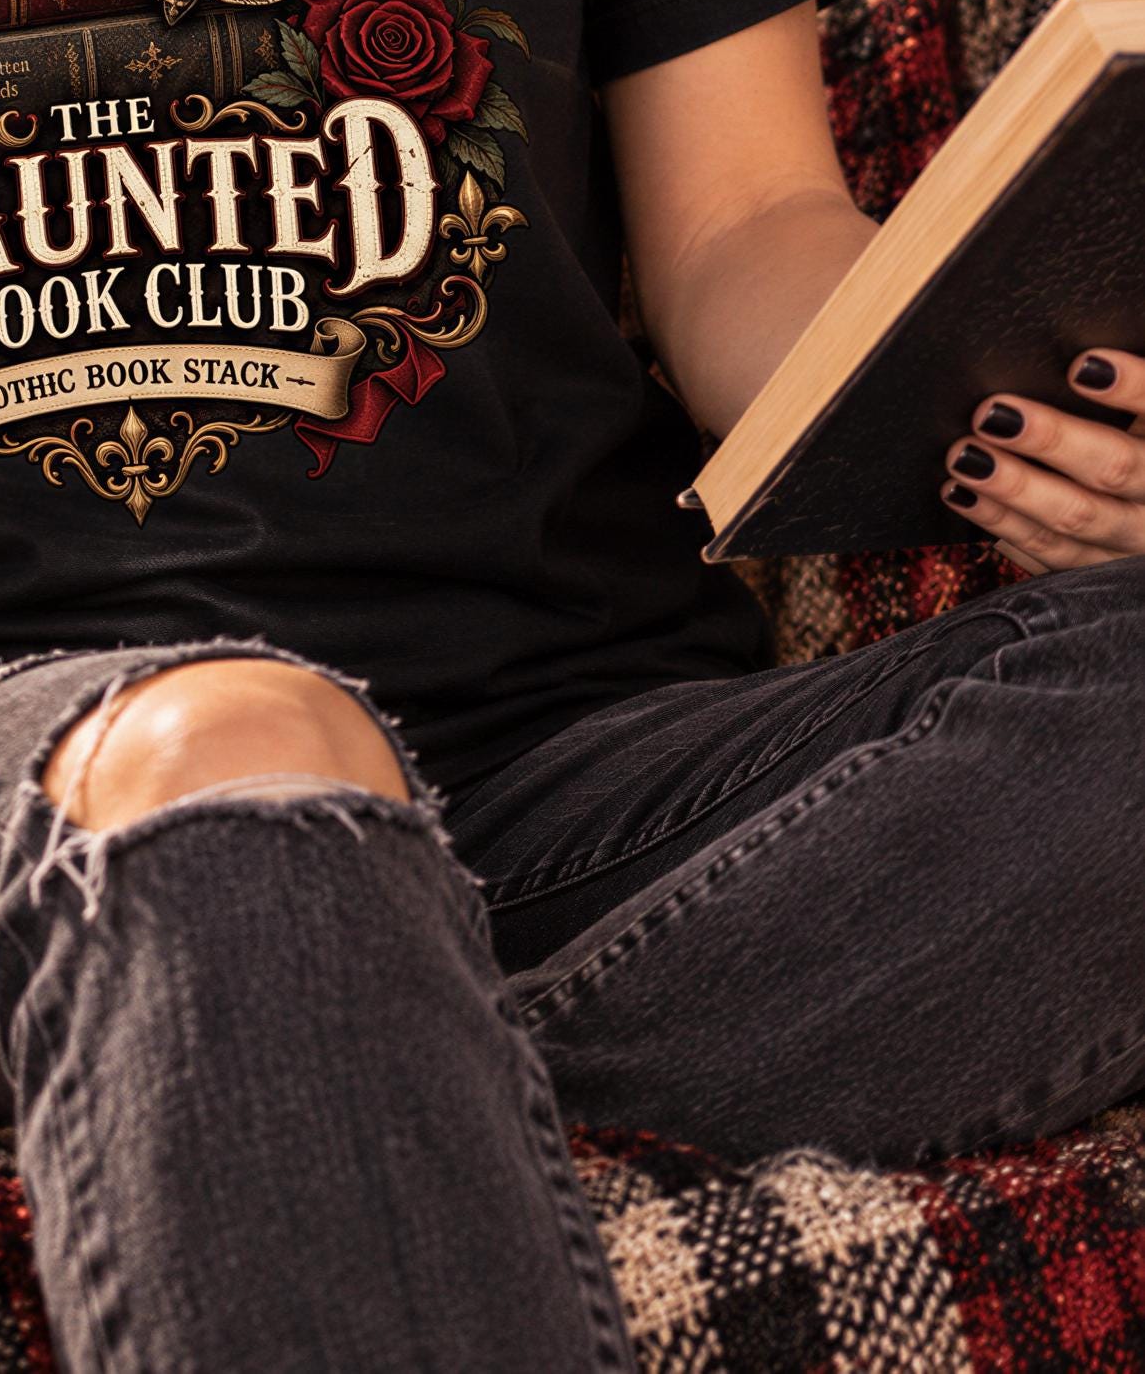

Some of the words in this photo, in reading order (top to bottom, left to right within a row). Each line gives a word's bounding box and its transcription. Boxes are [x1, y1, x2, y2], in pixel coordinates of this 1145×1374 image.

[51, 96, 156, 143] THE
[144, 263, 309, 333] CLUB
[86, 358, 171, 390] BOOK
[184, 359, 281, 389] STACK
